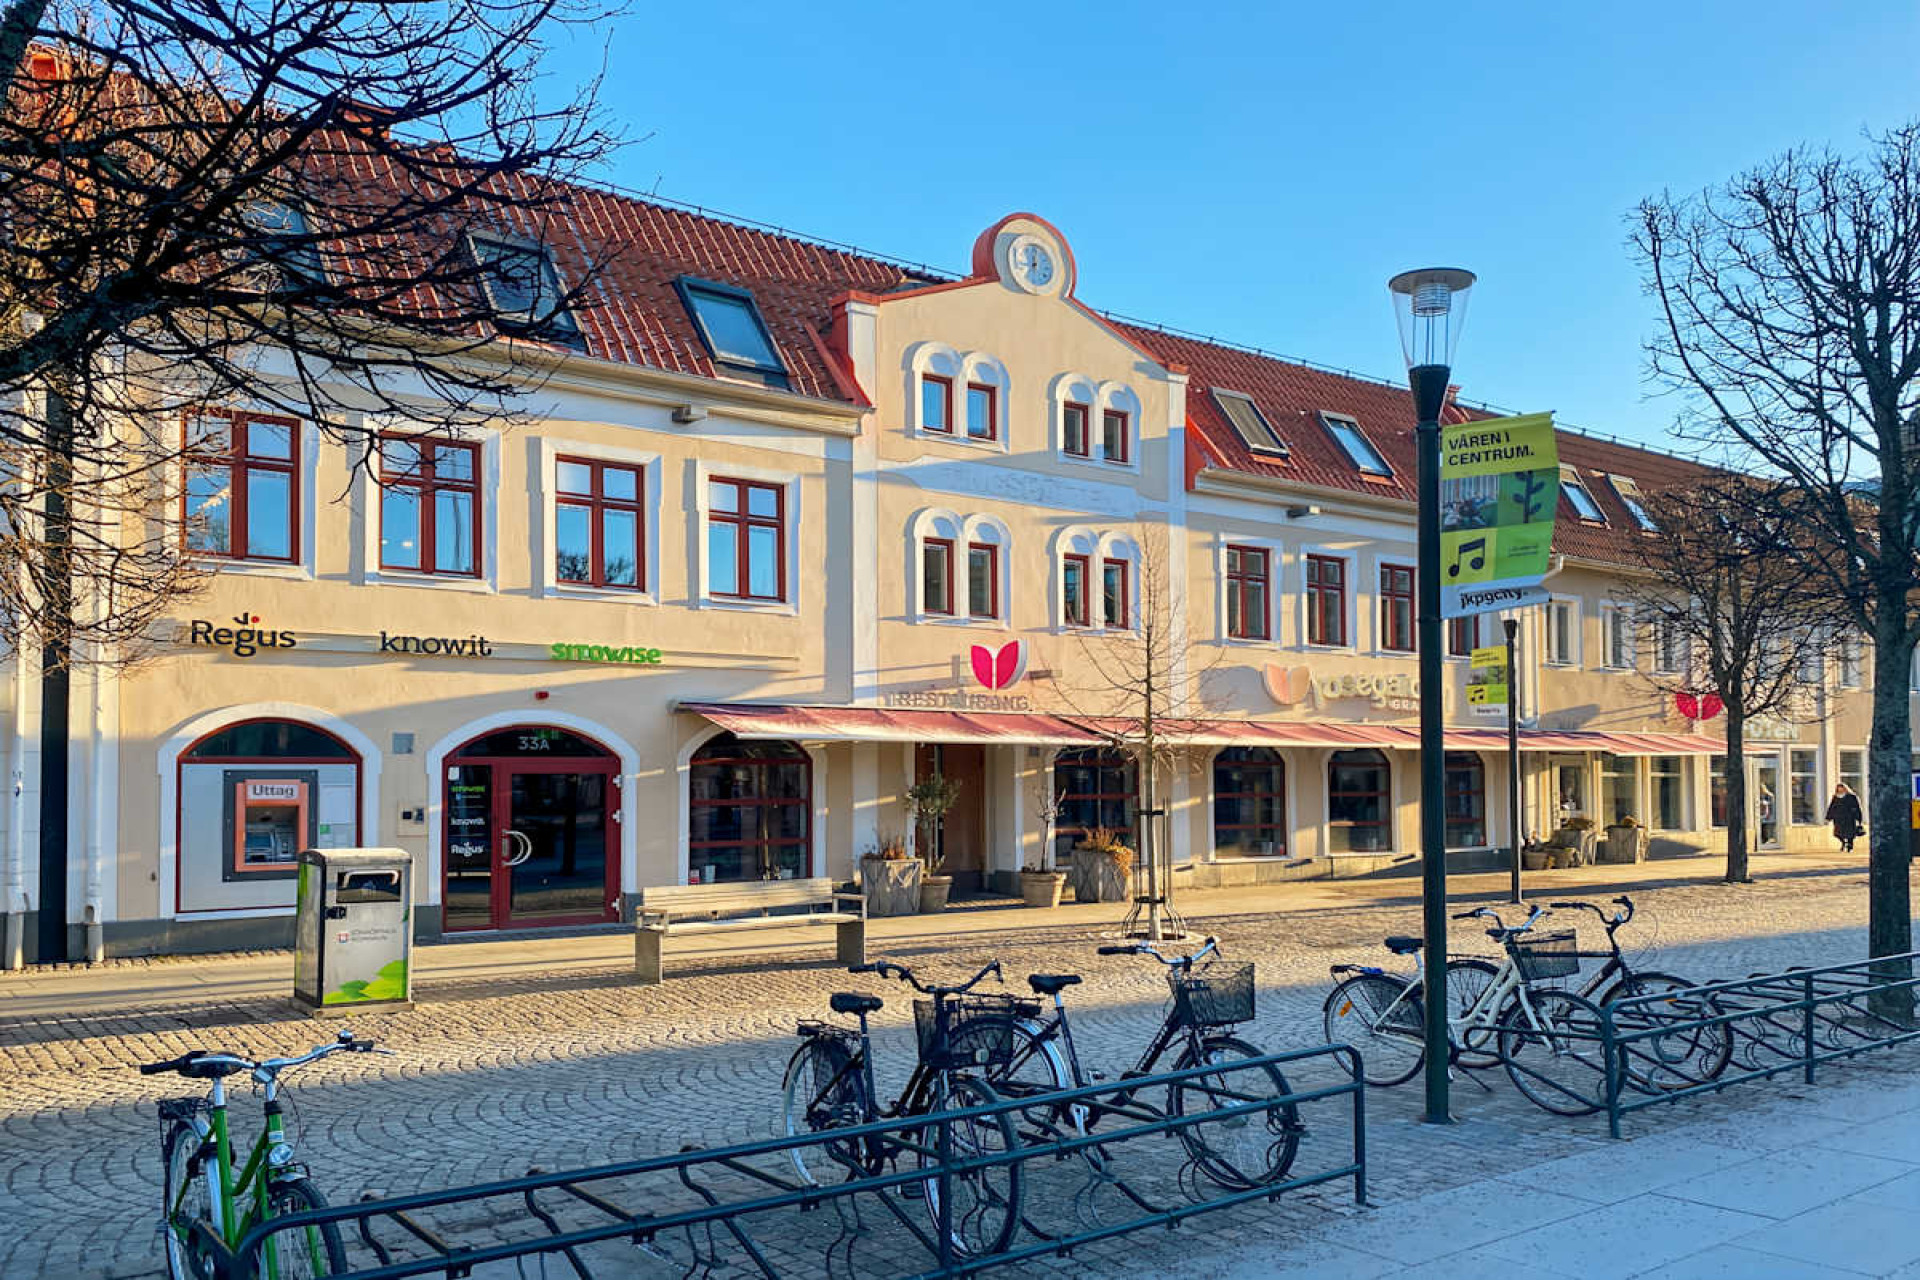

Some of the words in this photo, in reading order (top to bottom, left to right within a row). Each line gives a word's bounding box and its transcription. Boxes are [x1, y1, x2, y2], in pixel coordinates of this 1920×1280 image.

[1448, 431, 1502, 451] VÅREN
[1504, 431, 1511, 443] I
[1448, 444, 1536, 466] CENTRUM.
[191, 612, 297, 658] Regus
[379, 630, 493, 657] knowit
[517, 736, 550, 751] 33A
[252, 784, 295, 798] Uttag
[450, 842, 485, 857] Regus
